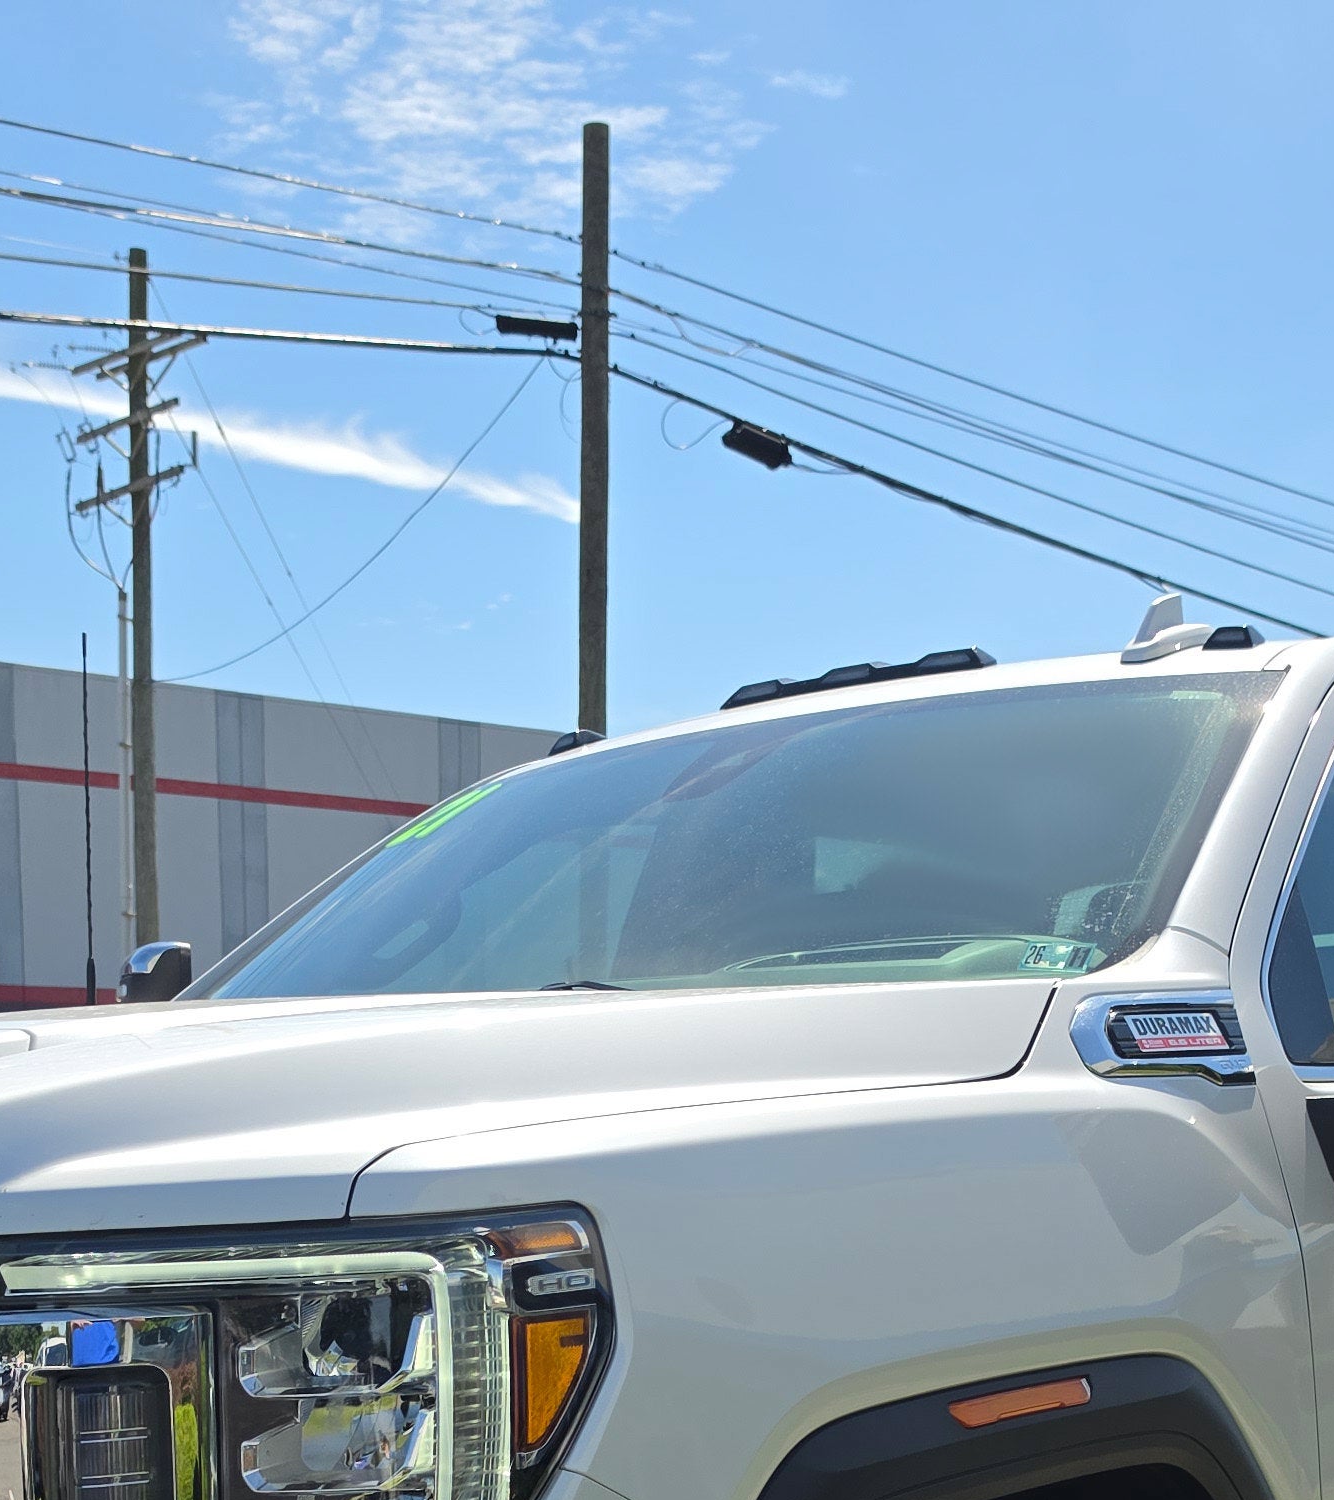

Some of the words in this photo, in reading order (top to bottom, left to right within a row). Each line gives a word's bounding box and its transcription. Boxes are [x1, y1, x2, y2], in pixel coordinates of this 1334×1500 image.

[1024, 945, 1047, 965] 26
[1131, 1015, 1217, 1036] DURAMAX
[537, 1274, 591, 1292] HD
